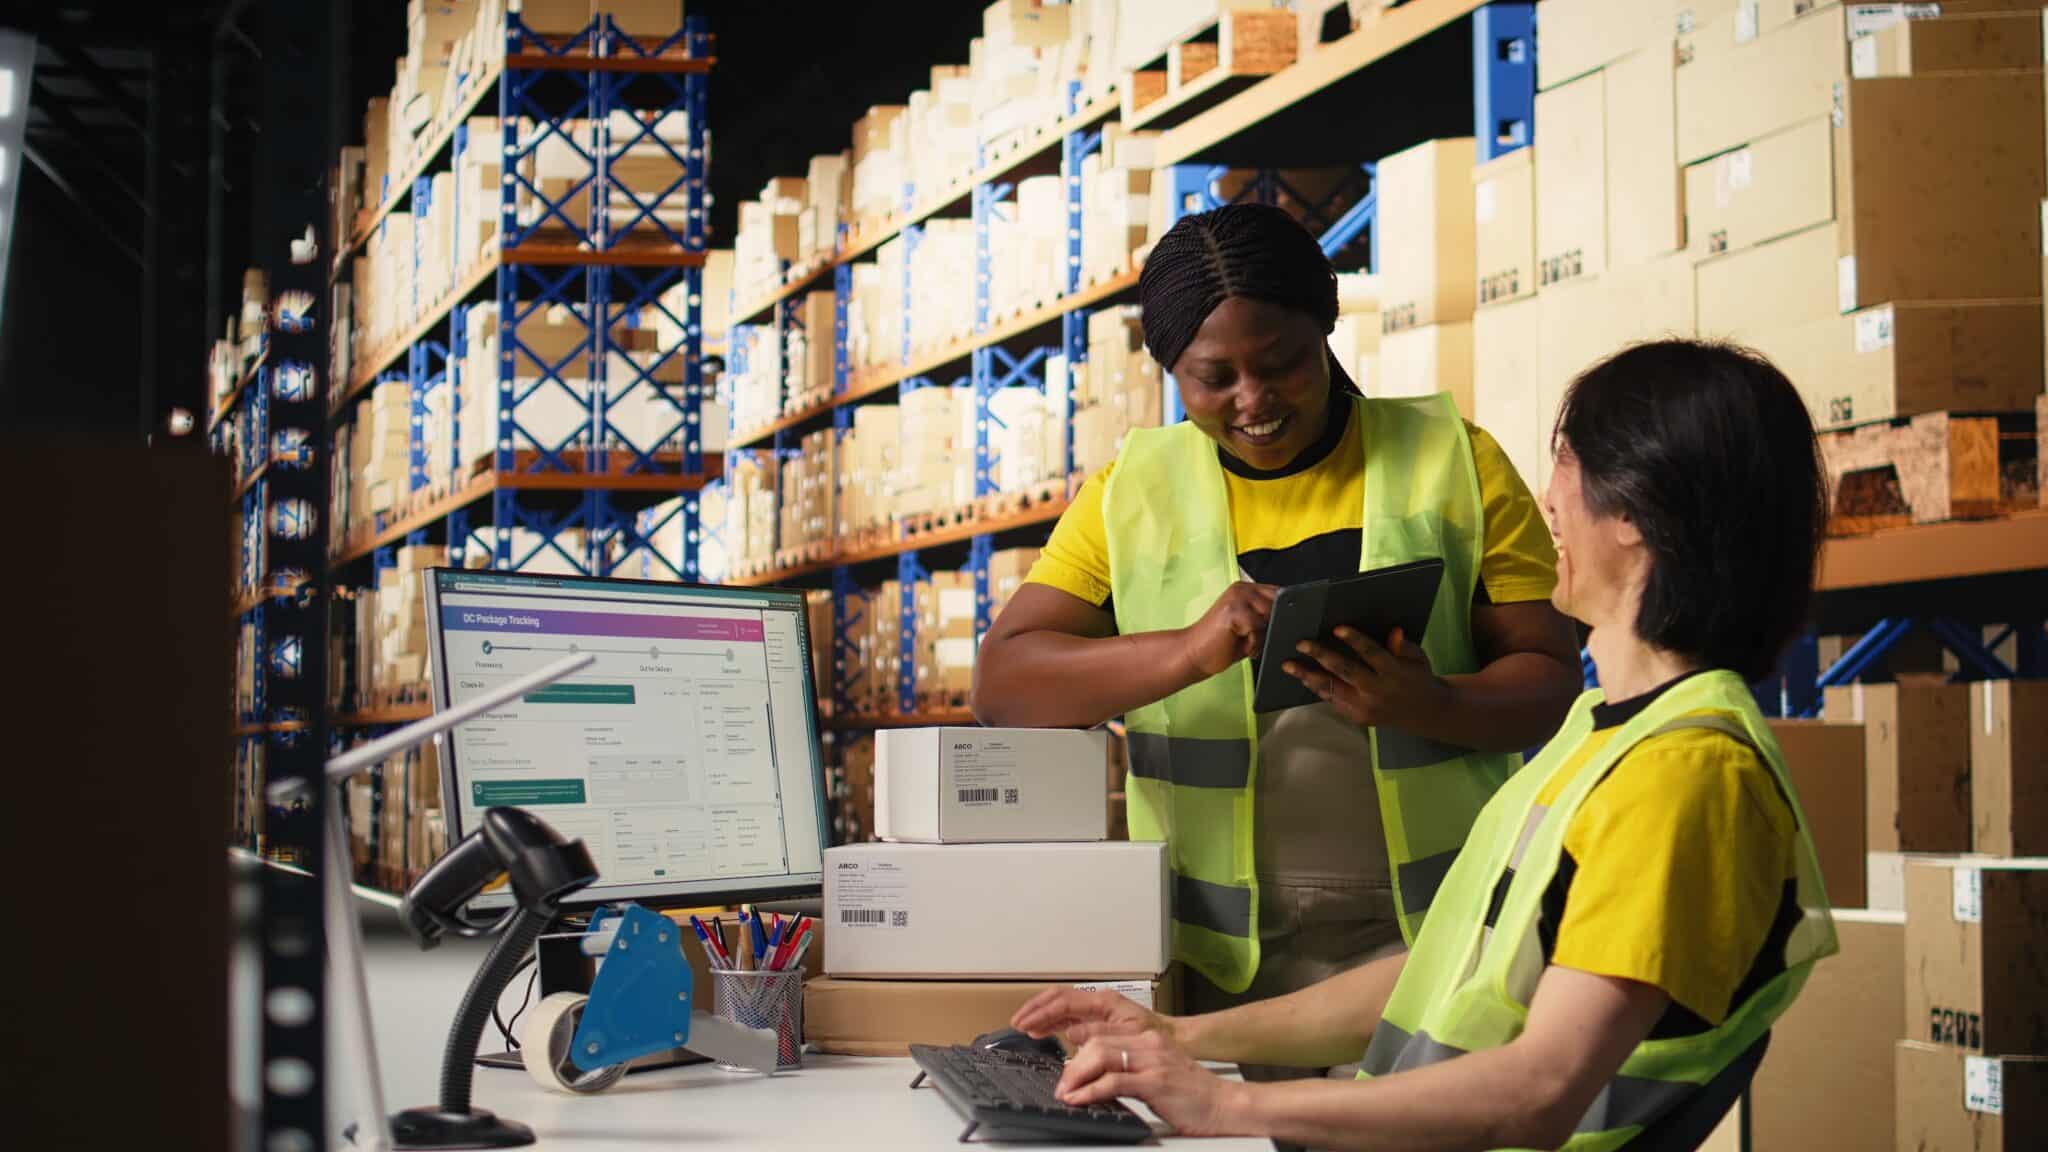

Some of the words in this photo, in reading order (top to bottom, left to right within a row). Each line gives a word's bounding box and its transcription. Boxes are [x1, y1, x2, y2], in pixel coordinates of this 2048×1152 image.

[463, 613, 475, 623] DC
[477, 614, 507, 626] Package
[509, 615, 540, 628] Tracking
